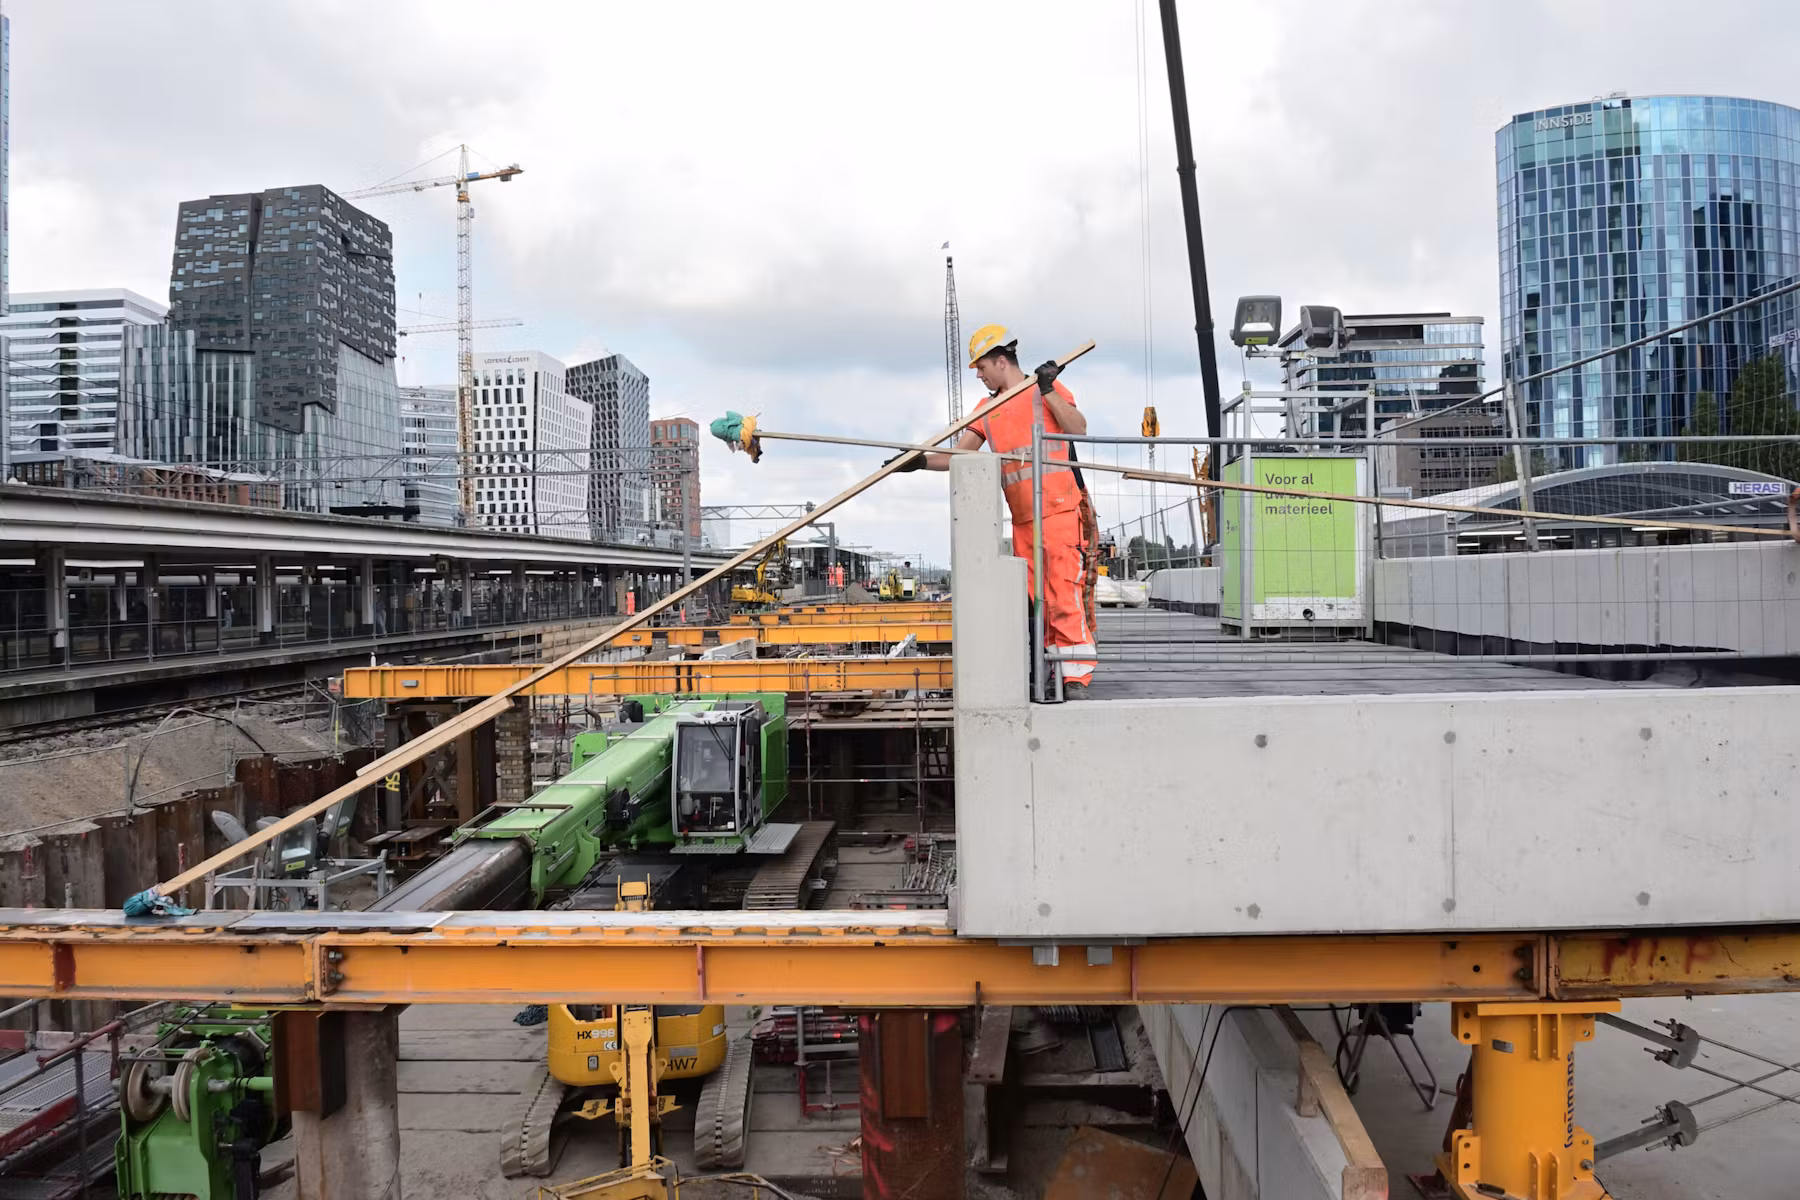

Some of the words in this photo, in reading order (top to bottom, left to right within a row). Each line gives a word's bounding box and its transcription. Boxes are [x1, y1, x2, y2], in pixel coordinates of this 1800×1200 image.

[1265, 473, 1297, 485] Voor
[1301, 473, 1314, 485] al
[1265, 503, 1333, 515] materieel
